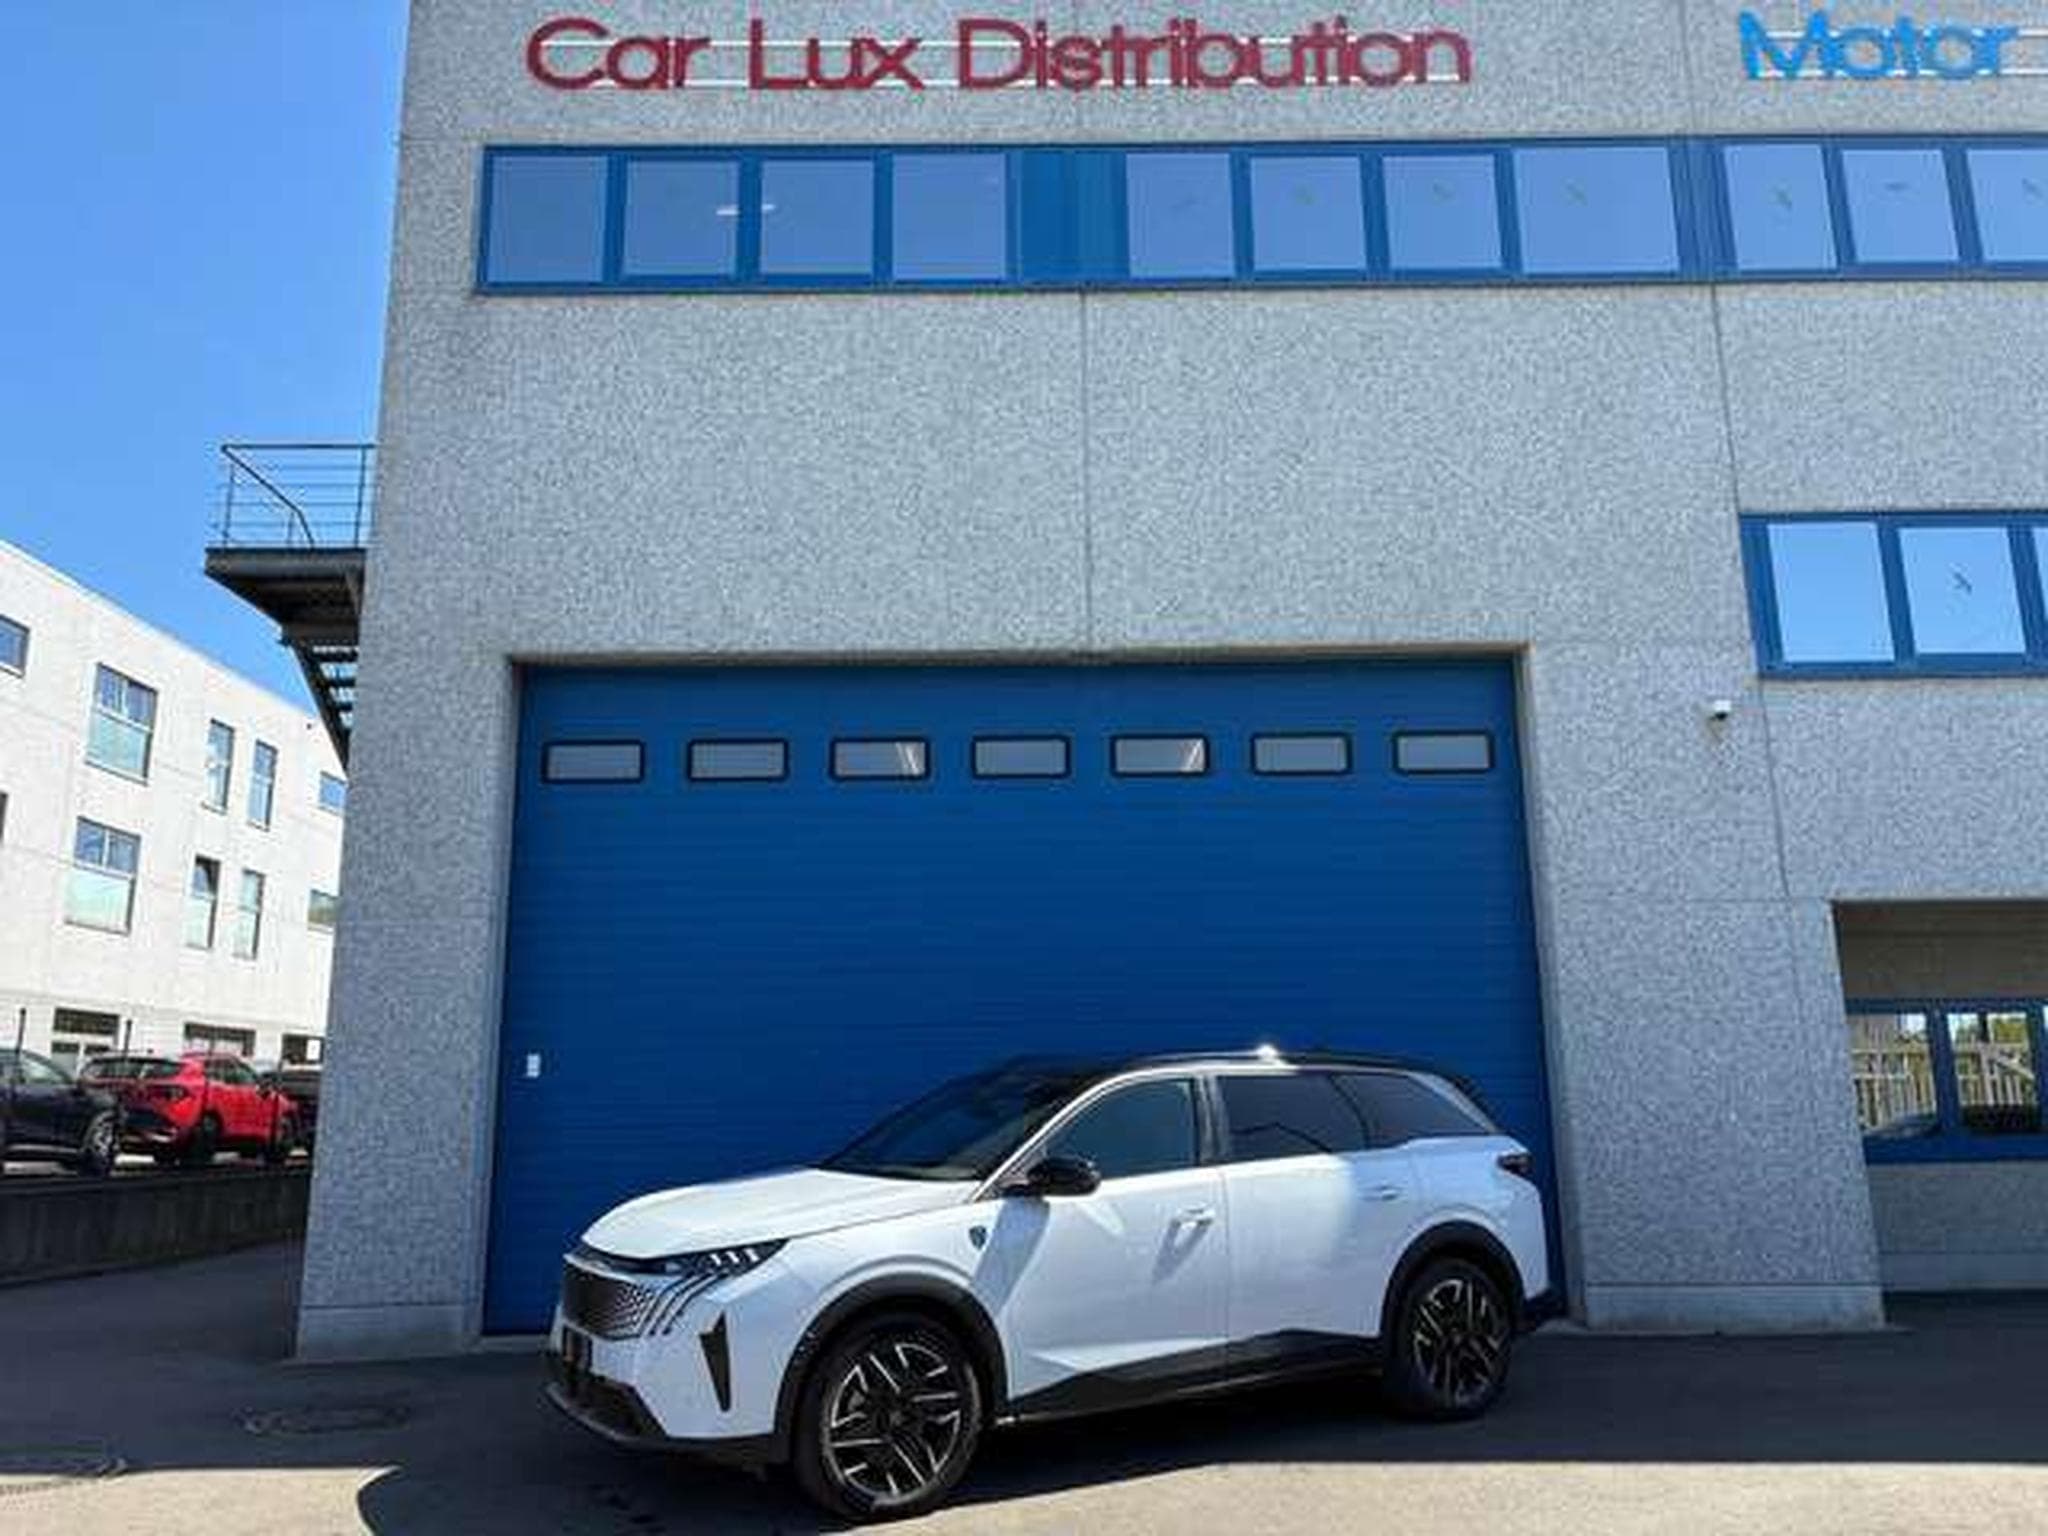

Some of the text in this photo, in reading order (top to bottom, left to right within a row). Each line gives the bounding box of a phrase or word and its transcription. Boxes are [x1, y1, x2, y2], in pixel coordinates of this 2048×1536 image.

[526, 15, 1472, 91] Car Lux Distribution
[1738, 10, 2018, 80] Motor
